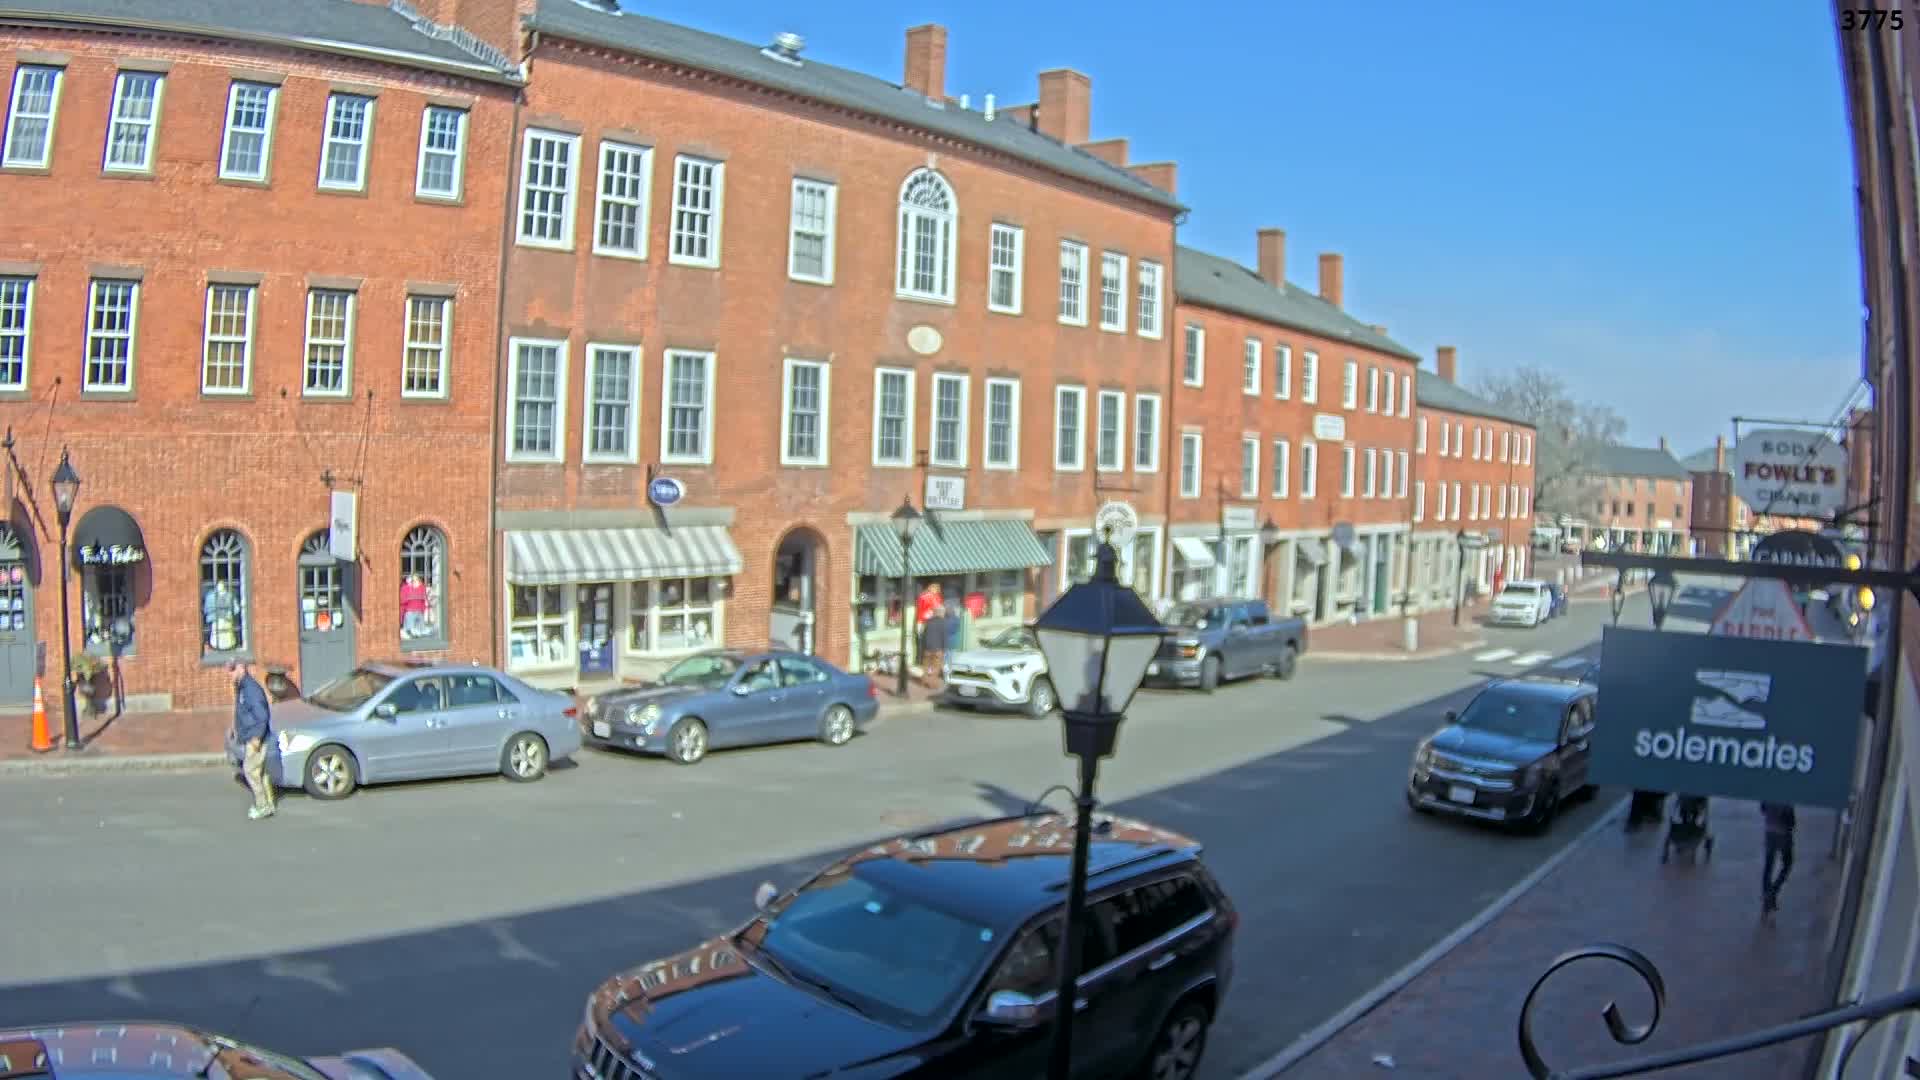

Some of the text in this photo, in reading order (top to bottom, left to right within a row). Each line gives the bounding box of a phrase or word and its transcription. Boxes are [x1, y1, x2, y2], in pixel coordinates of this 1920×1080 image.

[1760, 439, 1818, 457] SODA
[1743, 462, 1837, 484] FOWLE'S
[1634, 726, 1815, 773] solemates
